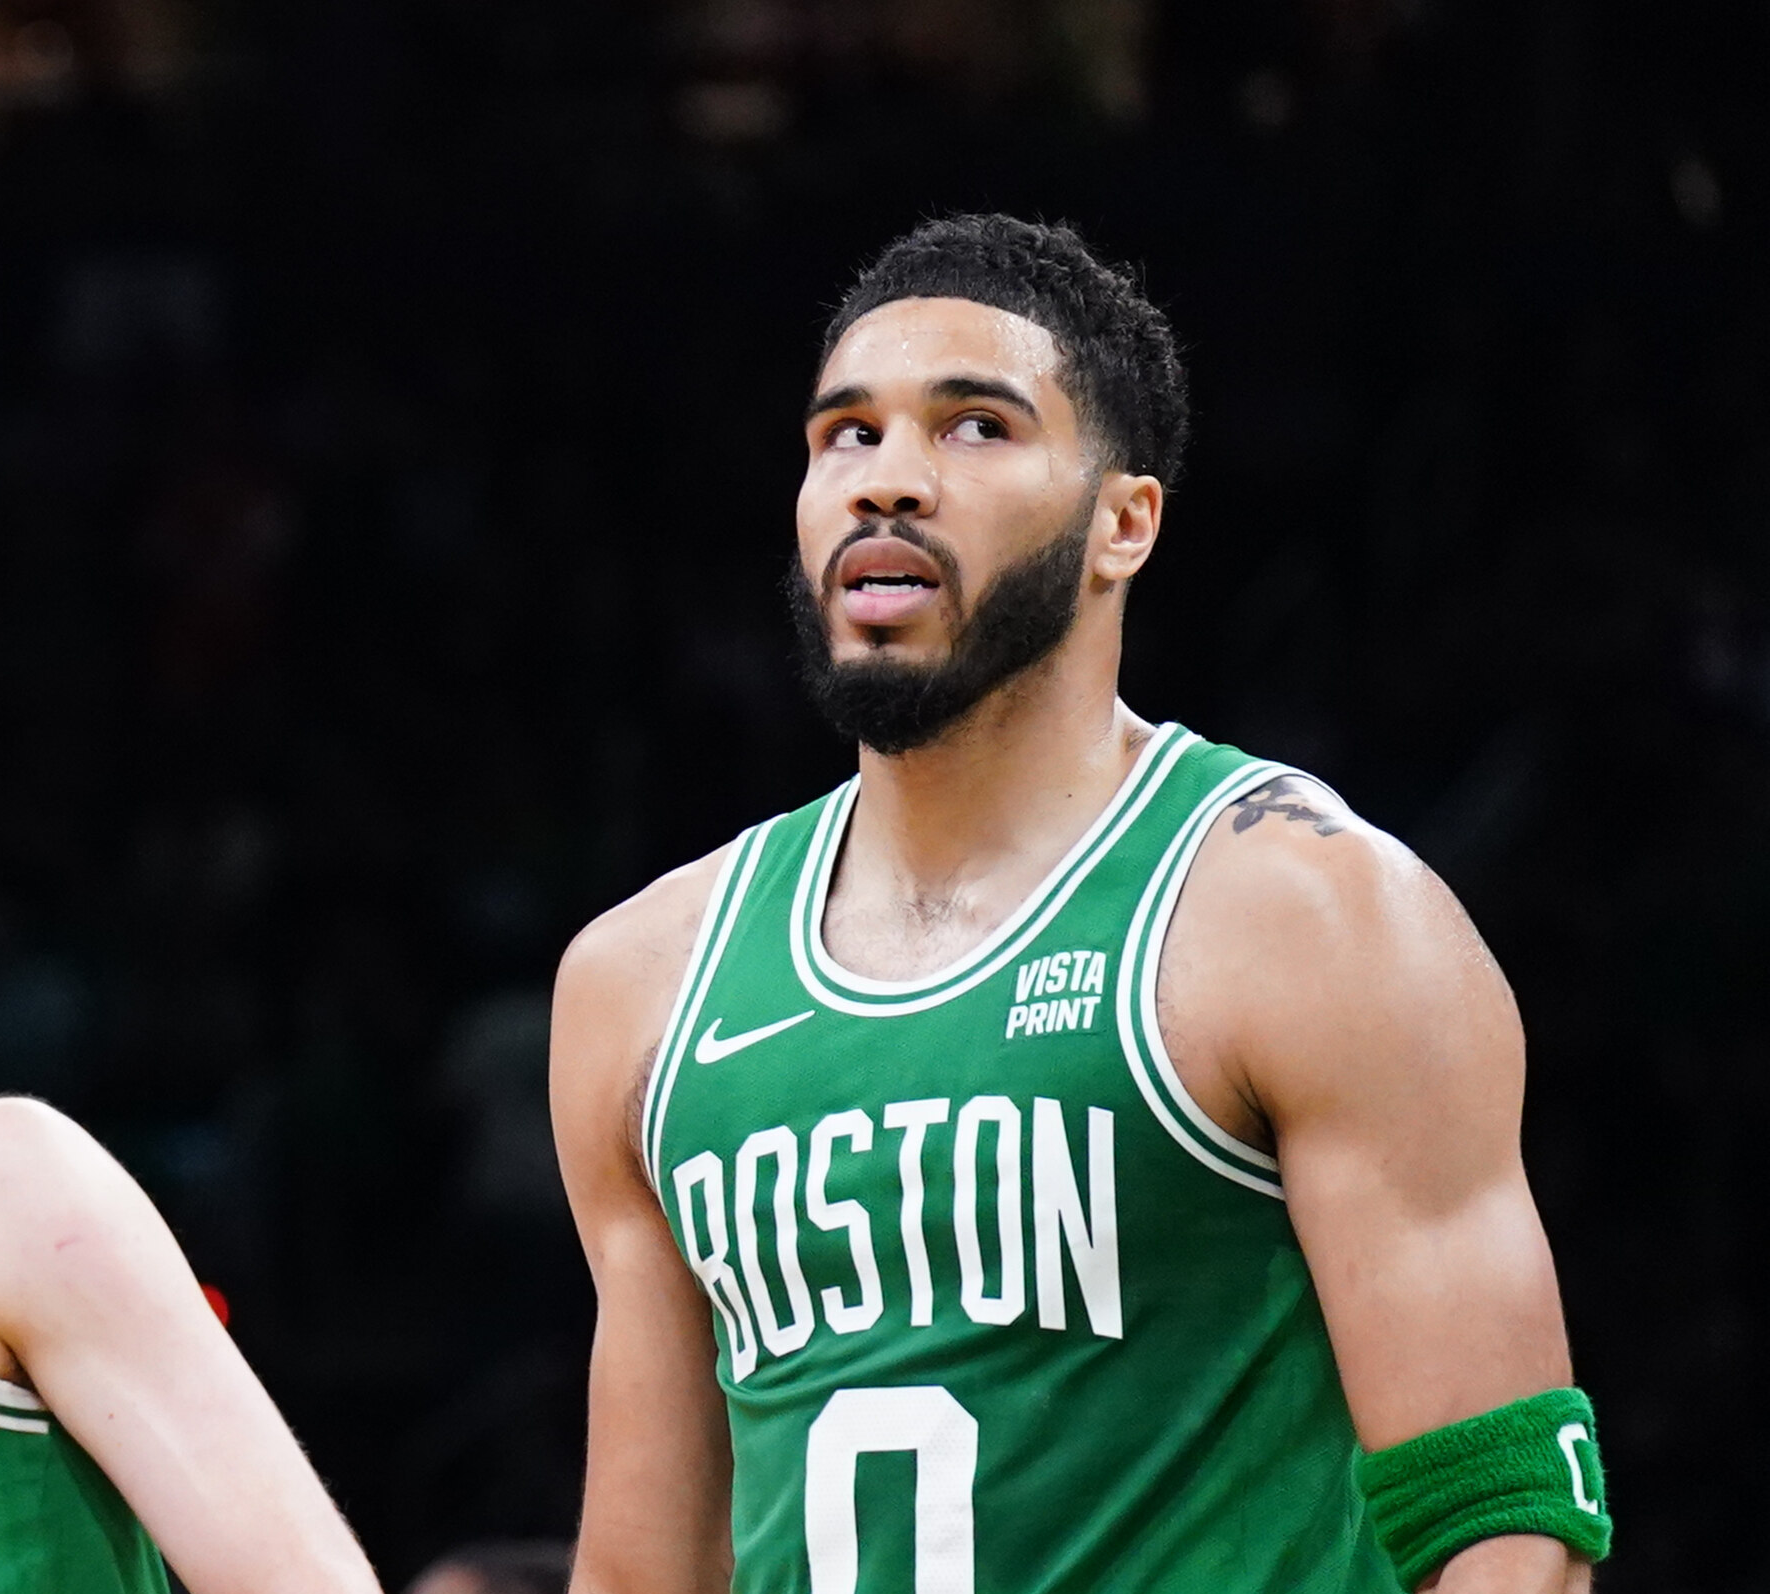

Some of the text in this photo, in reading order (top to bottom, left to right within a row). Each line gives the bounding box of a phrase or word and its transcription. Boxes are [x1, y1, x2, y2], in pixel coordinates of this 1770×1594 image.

[1015, 950, 1107, 1003] VISTA
[1005, 996, 1102, 1039] PRINT
[672, 1095, 1124, 1384] BOSTON
